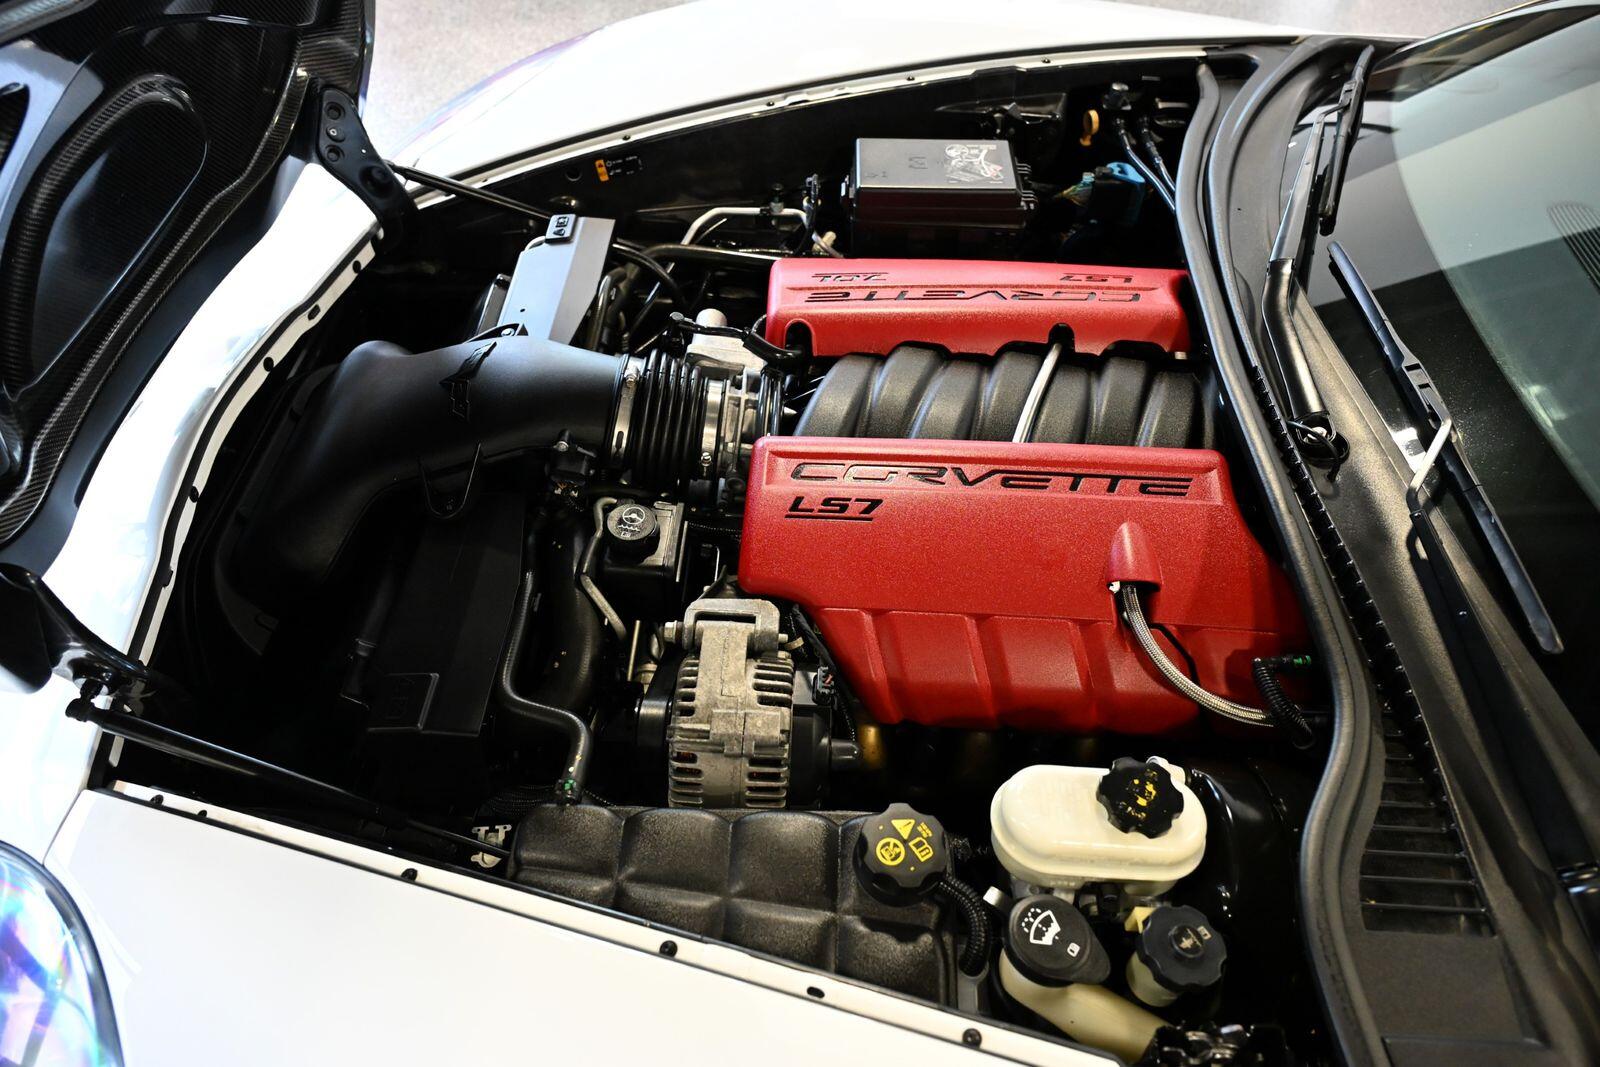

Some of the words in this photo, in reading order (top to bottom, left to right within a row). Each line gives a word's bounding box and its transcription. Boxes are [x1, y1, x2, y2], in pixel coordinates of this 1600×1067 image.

[1059, 273, 1134, 284] LS7
[804, 290, 1141, 302] CORVETTE
[791, 462, 1194, 496] CORVETTE
[786, 496, 884, 519] LS7
